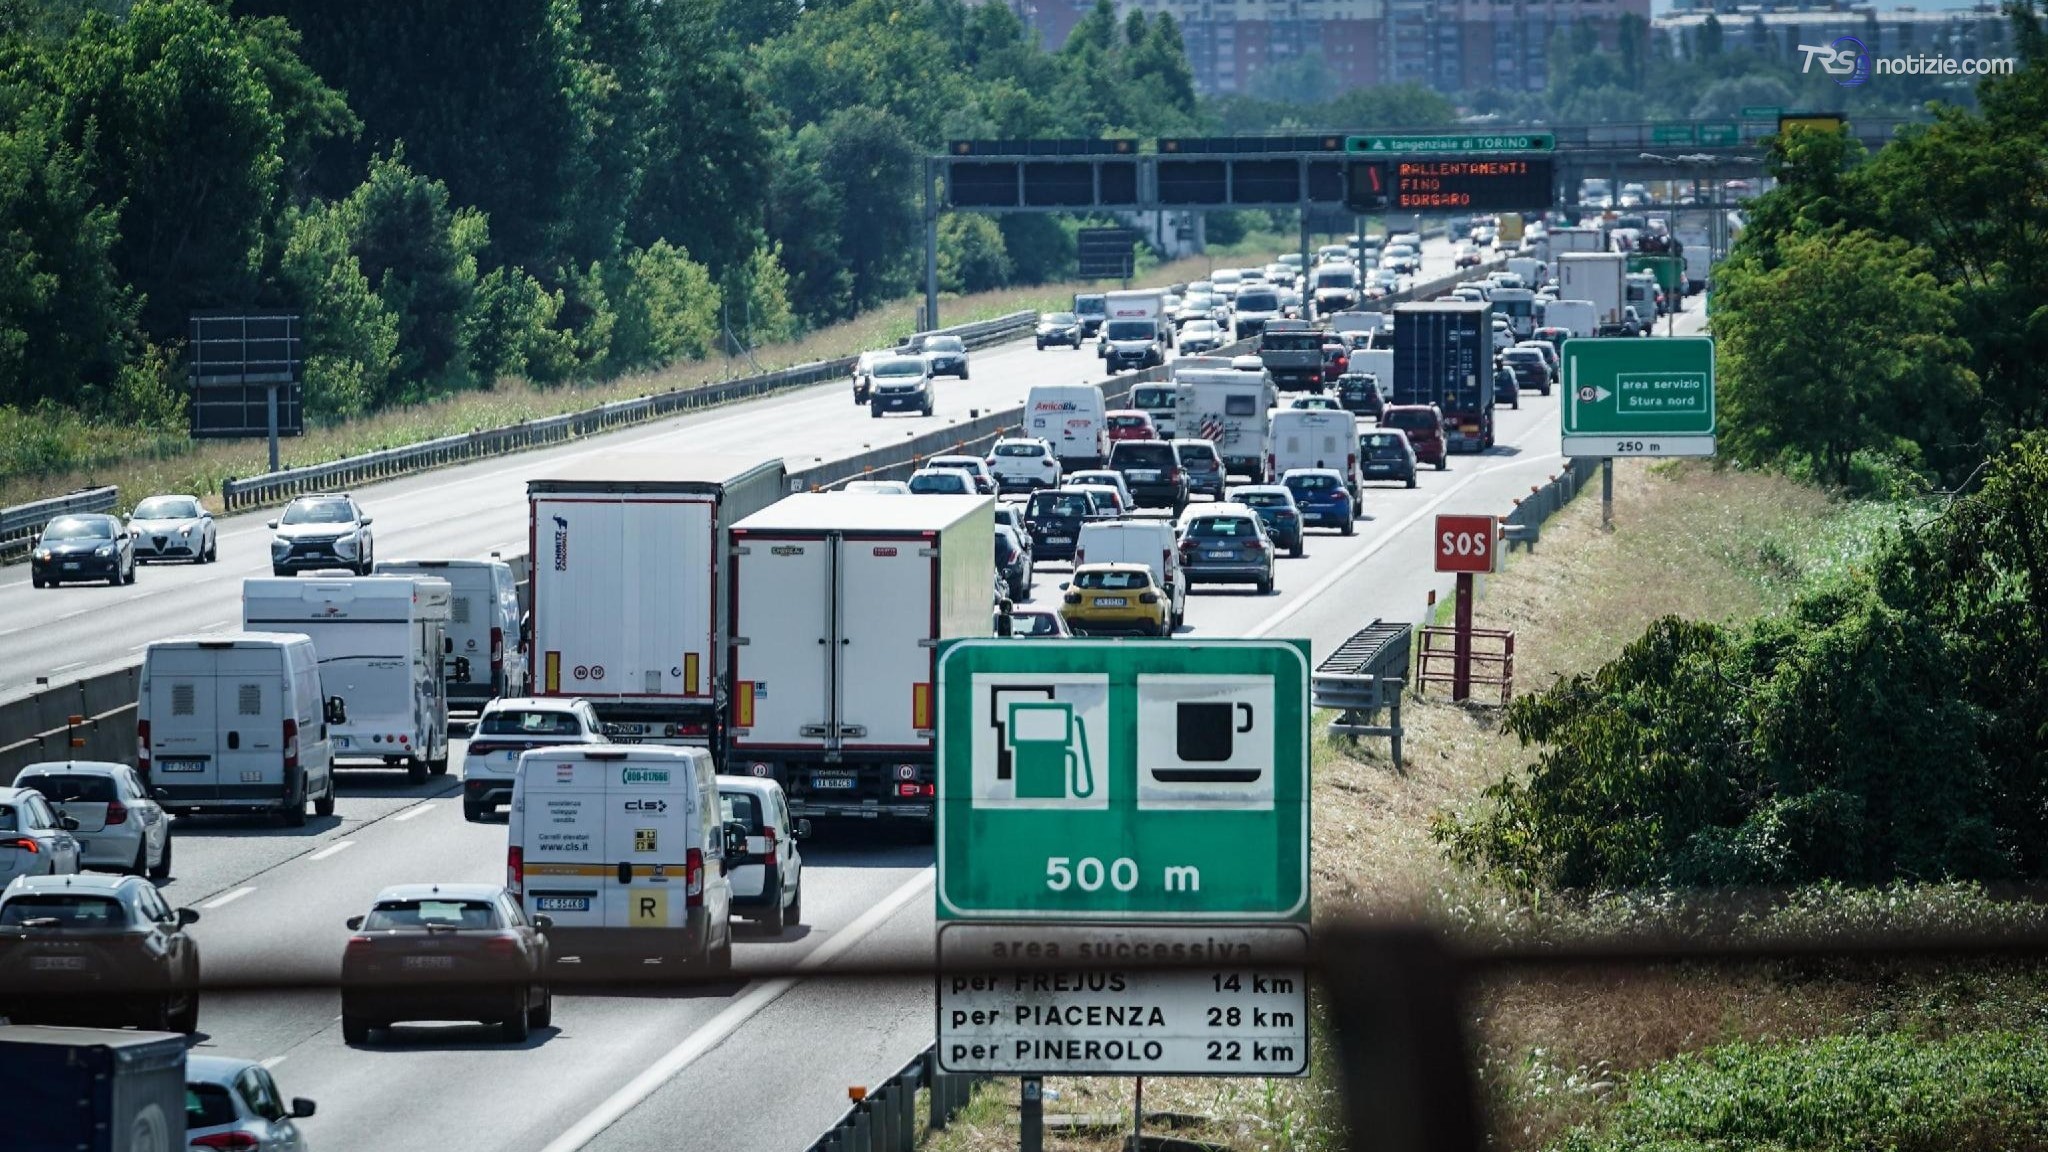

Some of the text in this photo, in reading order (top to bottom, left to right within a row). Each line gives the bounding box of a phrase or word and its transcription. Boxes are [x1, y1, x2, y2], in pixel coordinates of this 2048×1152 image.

[1391, 137, 1528, 151] tangenziale di TORINO
[1399, 162, 1528, 176] RALLENTAMENTI
[1400, 178, 1440, 190] FINO
[1400, 193, 1470, 206] BORGARO
[1622, 378, 1700, 390] area servizio
[1629, 395, 1695, 406] Stura nord
[1616, 441, 1644, 452] 250
[1442, 531, 1486, 556] SOS
[624, 799, 658, 810] cls
[540, 842, 588, 851] www.cls.it
[1046, 857, 1200, 892] 500 m
[640, 897, 656, 918] R
[992, 937, 1252, 961] area successiva
[952, 971, 1294, 995] per FREJUS 14 km
[952, 1006, 1294, 1029] per PIACENZA 28 km
[952, 1040, 1294, 1063] per PINEROLO 22 km
